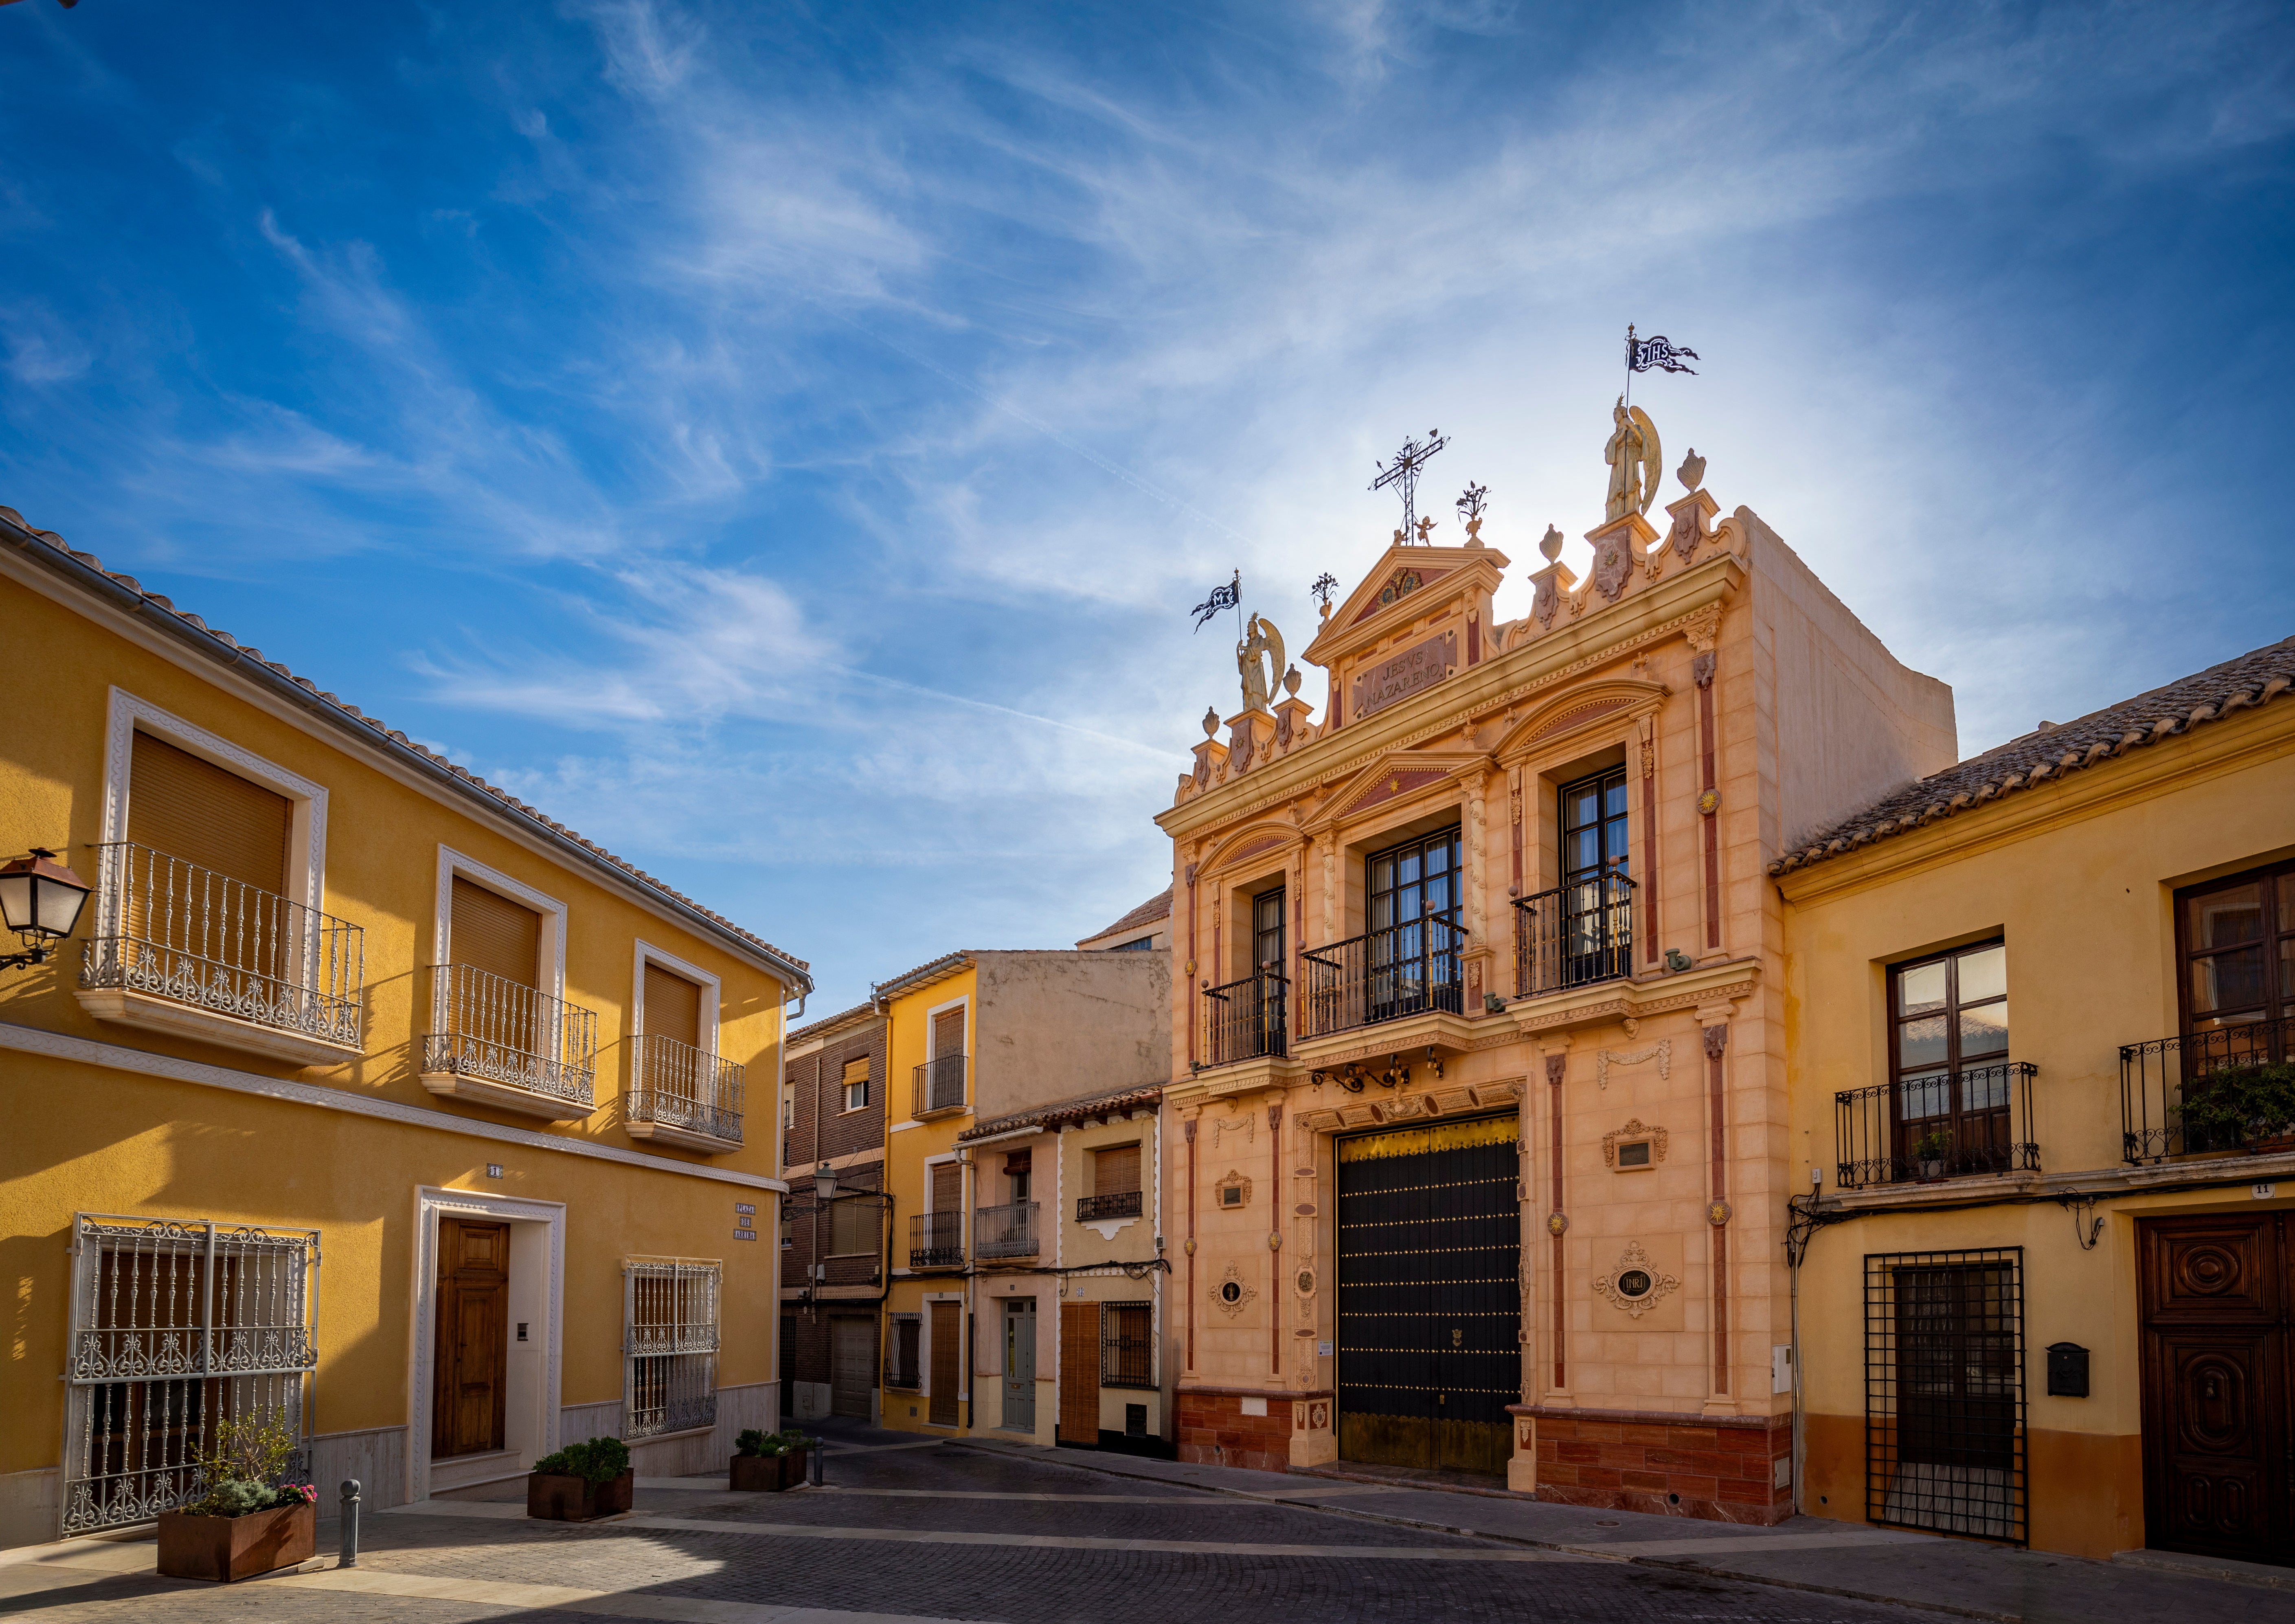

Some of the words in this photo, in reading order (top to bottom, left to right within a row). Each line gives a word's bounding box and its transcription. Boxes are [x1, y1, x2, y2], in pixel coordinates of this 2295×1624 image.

[1382, 650, 1424, 680] JESVS
[1366, 662, 1439, 708] NAZARENO
[493, 1167, 497, 1176] 1
[2256, 1184, 2269, 1194] 11
[738, 1205, 753, 1214] PLAZA
[736, 1231, 754, 1239] ARRIBA
